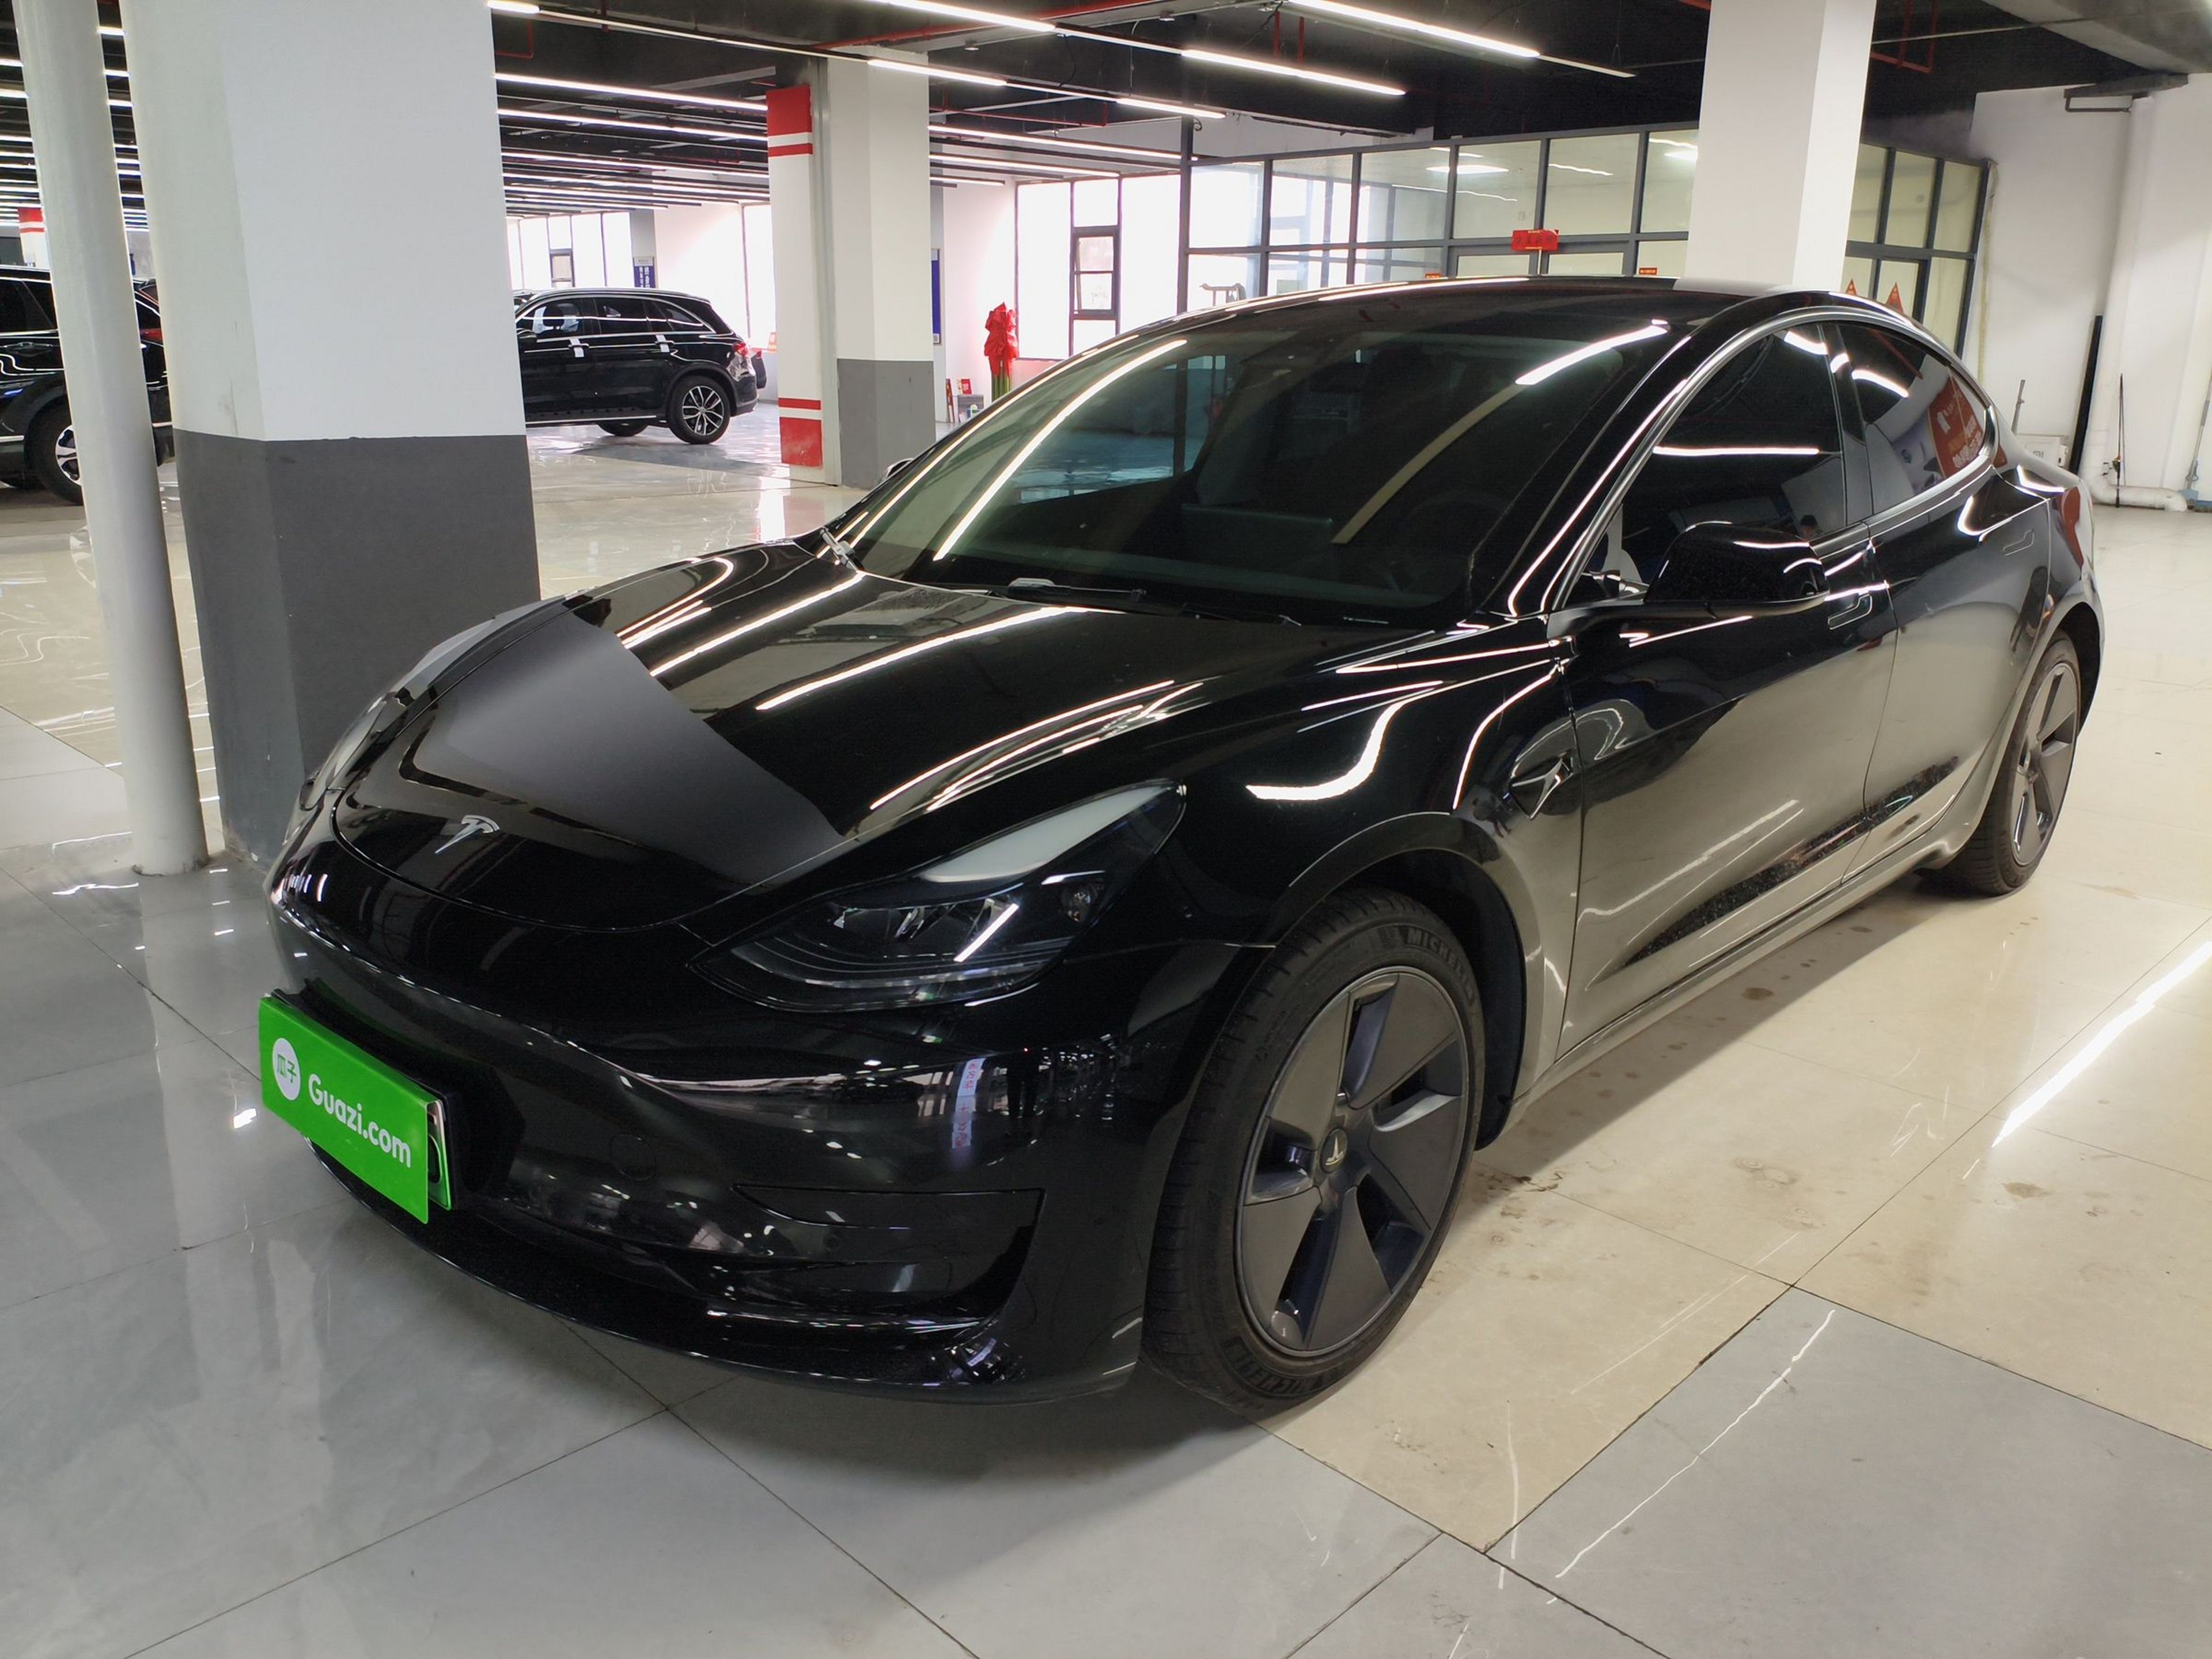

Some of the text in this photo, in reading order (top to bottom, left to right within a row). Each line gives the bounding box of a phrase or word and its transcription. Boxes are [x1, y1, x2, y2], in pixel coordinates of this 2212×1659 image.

[1407, 926, 1474, 1001] MICHELIN
[276, 1053, 297, 1084] 瓜子
[308, 1073, 412, 1168] Guazi.com
